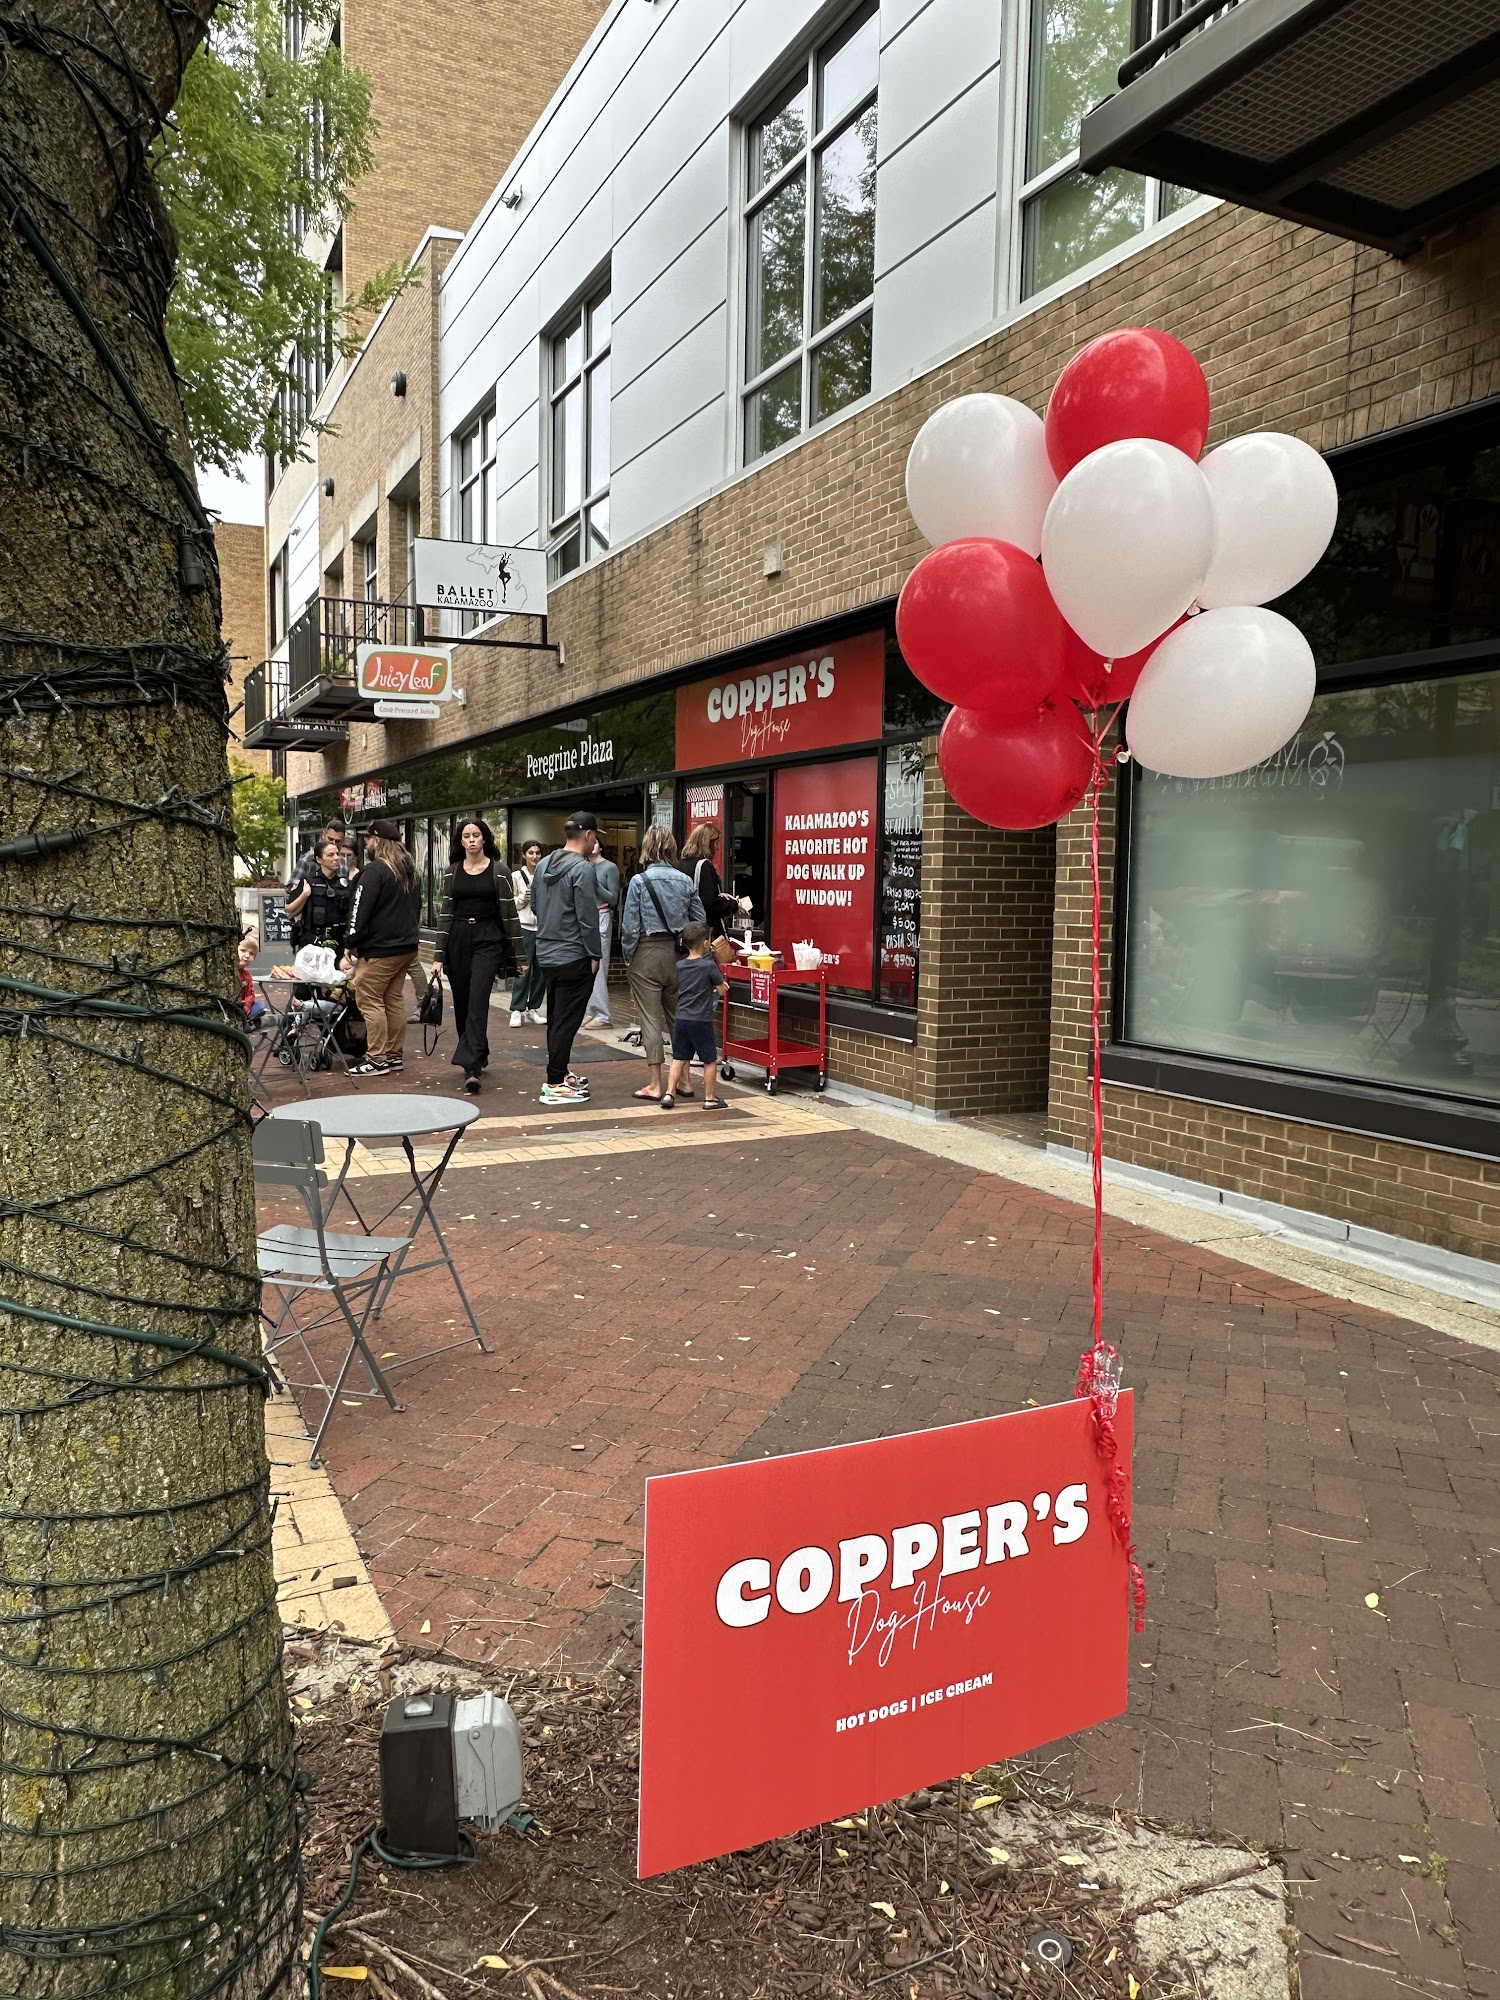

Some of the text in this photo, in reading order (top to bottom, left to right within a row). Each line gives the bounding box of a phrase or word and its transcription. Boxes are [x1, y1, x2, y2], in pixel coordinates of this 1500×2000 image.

[437, 584, 494, 599] BALLET
[437, 596, 494, 607] KALAMAZOO
[707, 656, 835, 723] COPPER'S
[741, 707, 790, 757] Dog House
[526, 734, 614, 780] Peregrine Plaza
[691, 800, 718, 818] MENU
[785, 809, 869, 831] KALAMAZOO'S
[785, 837, 868, 855] FAVORITE HOT
[786, 864, 865, 880] DOG WALK UP
[795, 889, 852, 907] WINDOW!
[715, 1482, 1090, 1629] COPPER'S
[847, 1571, 991, 1668] Dog House
[836, 1712, 866, 1733] HOT
[868, 1699, 909, 1723] DOGS
[919, 1688, 944, 1708] ICE
[945, 1672, 993, 1698] CREAM
